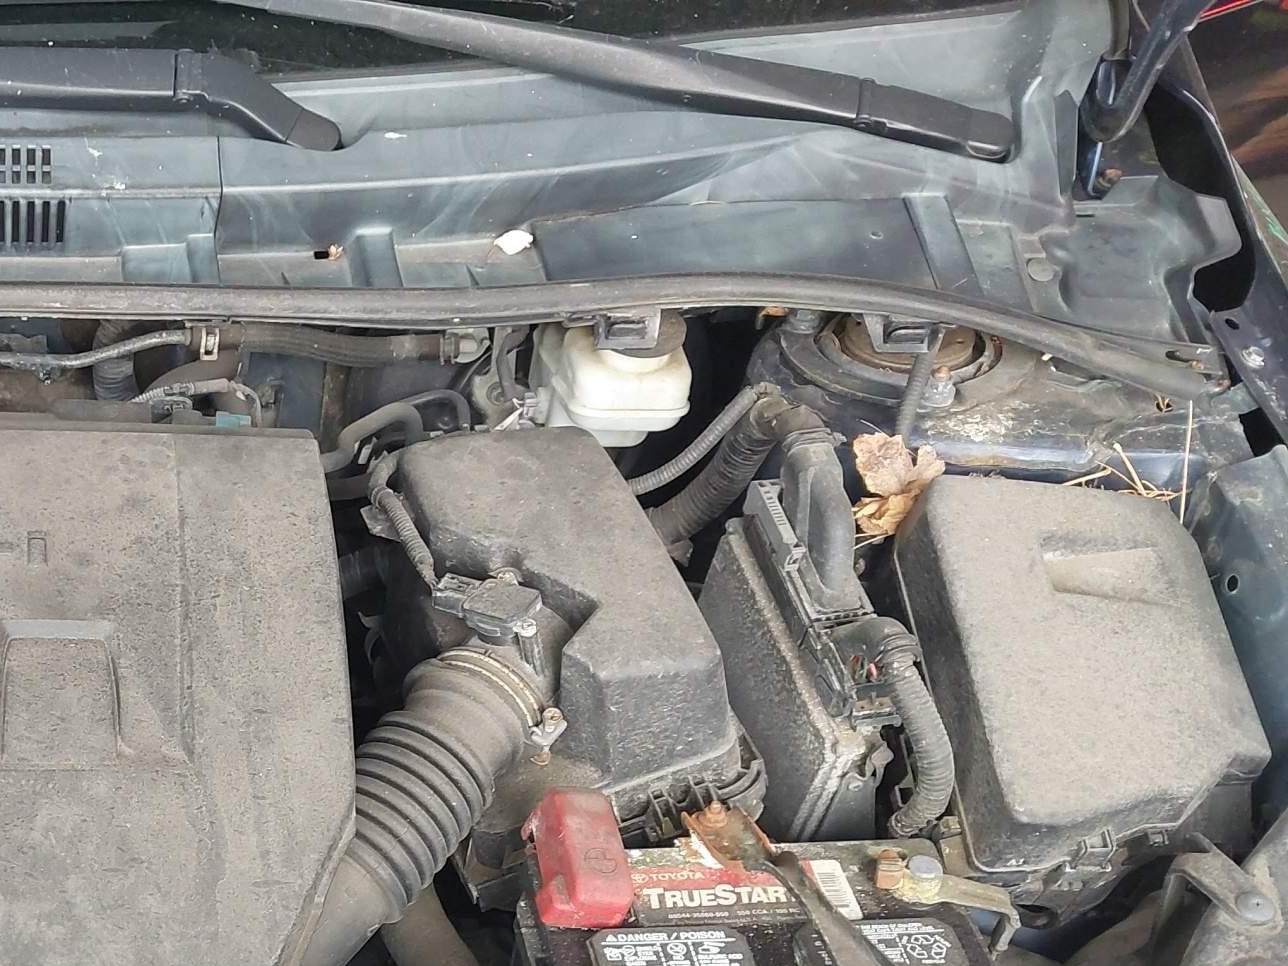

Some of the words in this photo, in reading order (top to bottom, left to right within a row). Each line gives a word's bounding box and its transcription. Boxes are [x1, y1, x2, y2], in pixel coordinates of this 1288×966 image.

[649, 870, 706, 882] TOYOTA
[617, 931, 669, 942] DANGER
[679, 930, 726, 940] POISON
